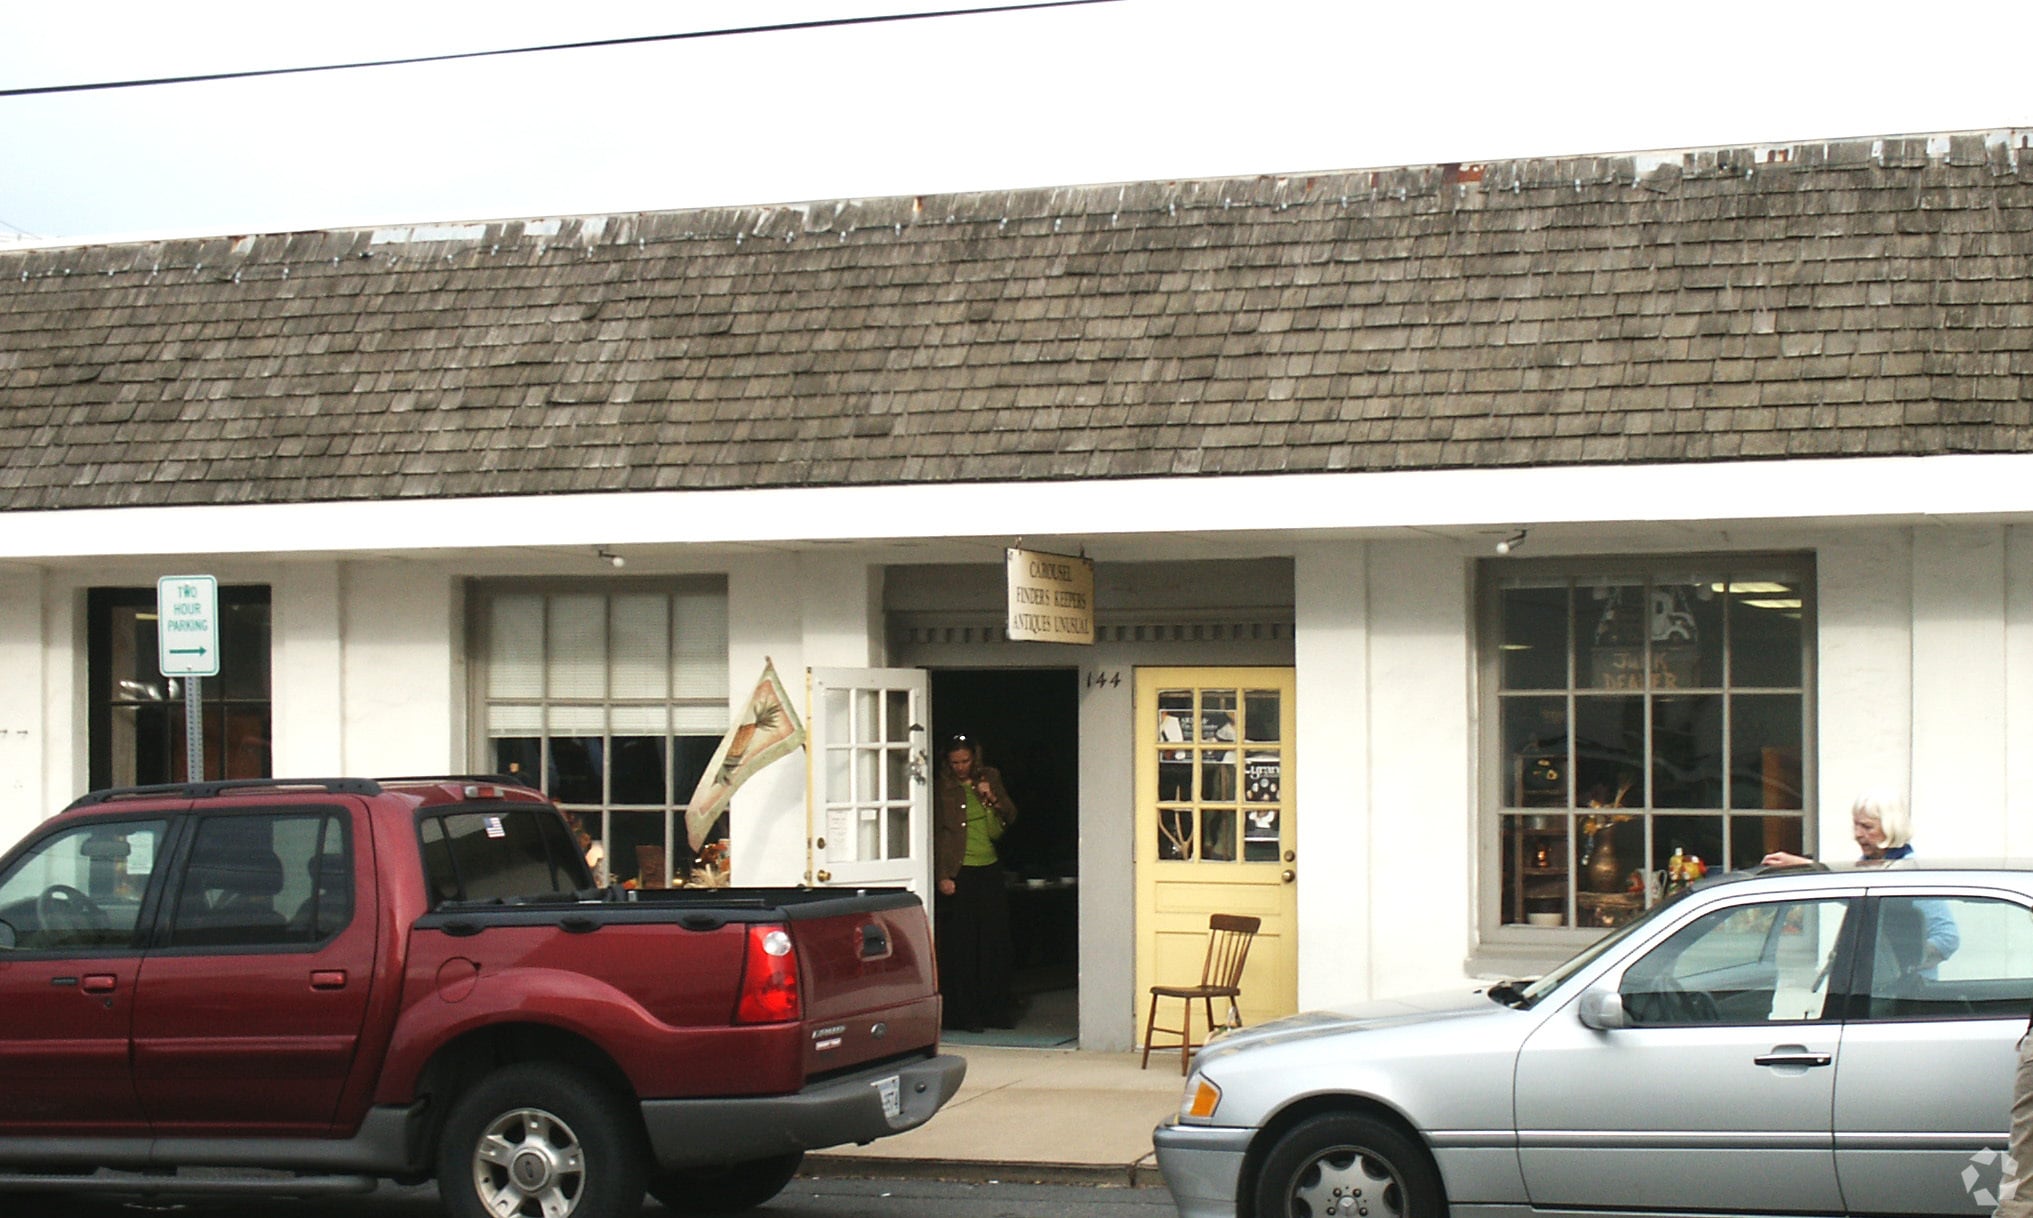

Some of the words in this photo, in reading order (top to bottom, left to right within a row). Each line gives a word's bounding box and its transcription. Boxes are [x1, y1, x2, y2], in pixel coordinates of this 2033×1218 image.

[1029, 561, 1073, 582] CAROUSEL
[177, 586, 198, 598] TWO
[173, 603, 201, 615] HOUR
[167, 619, 208, 632] PARKING
[1013, 613, 1051, 634] ANTIQUES
[1054, 616, 1090, 634] UNUSUAL
[1087, 671, 1122, 688] 144
